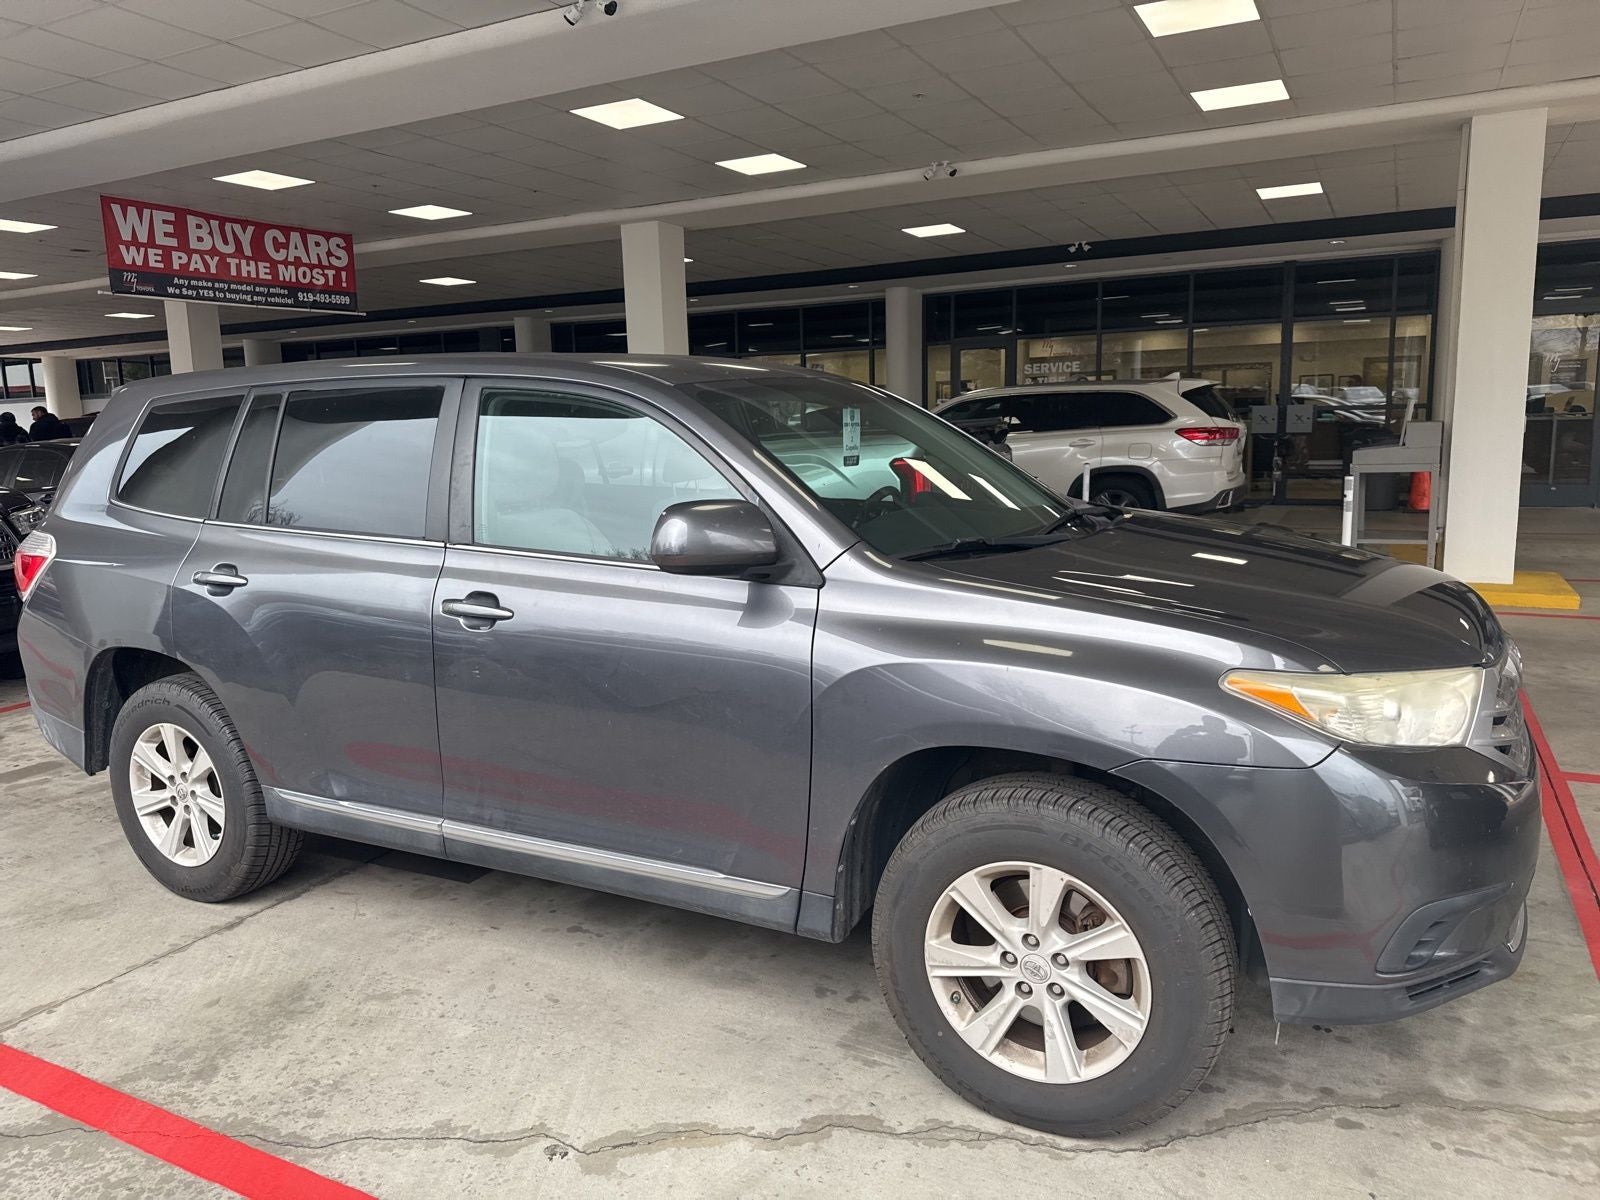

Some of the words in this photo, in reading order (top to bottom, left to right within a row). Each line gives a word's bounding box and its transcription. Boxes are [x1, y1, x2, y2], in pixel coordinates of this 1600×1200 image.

[110, 203, 178, 246] WE
[186, 214, 255, 257] BUY
[264, 229, 349, 268] CARS
[119, 244, 164, 269] WE
[171, 251, 220, 274] PAY
[227, 258, 272, 280] THE
[278, 265, 336, 287] MOST
[167, 286, 180, 294] We
[181, 287, 197, 297] Say
[198, 289, 214, 297] YES
[216, 290, 224, 298] to
[226, 291, 252, 302] buying
[253, 295, 267, 303] any
[267, 296, 294, 304] vehicle!
[173, 277, 189, 287] Any
[191, 278, 213, 287] make
[214, 281, 229, 290] any
[230, 283, 254, 292] model
[269, 287, 288, 295] miles
[297, 291, 350, 305] 919-493-5599
[1024, 361, 1081, 375] SERVICE
